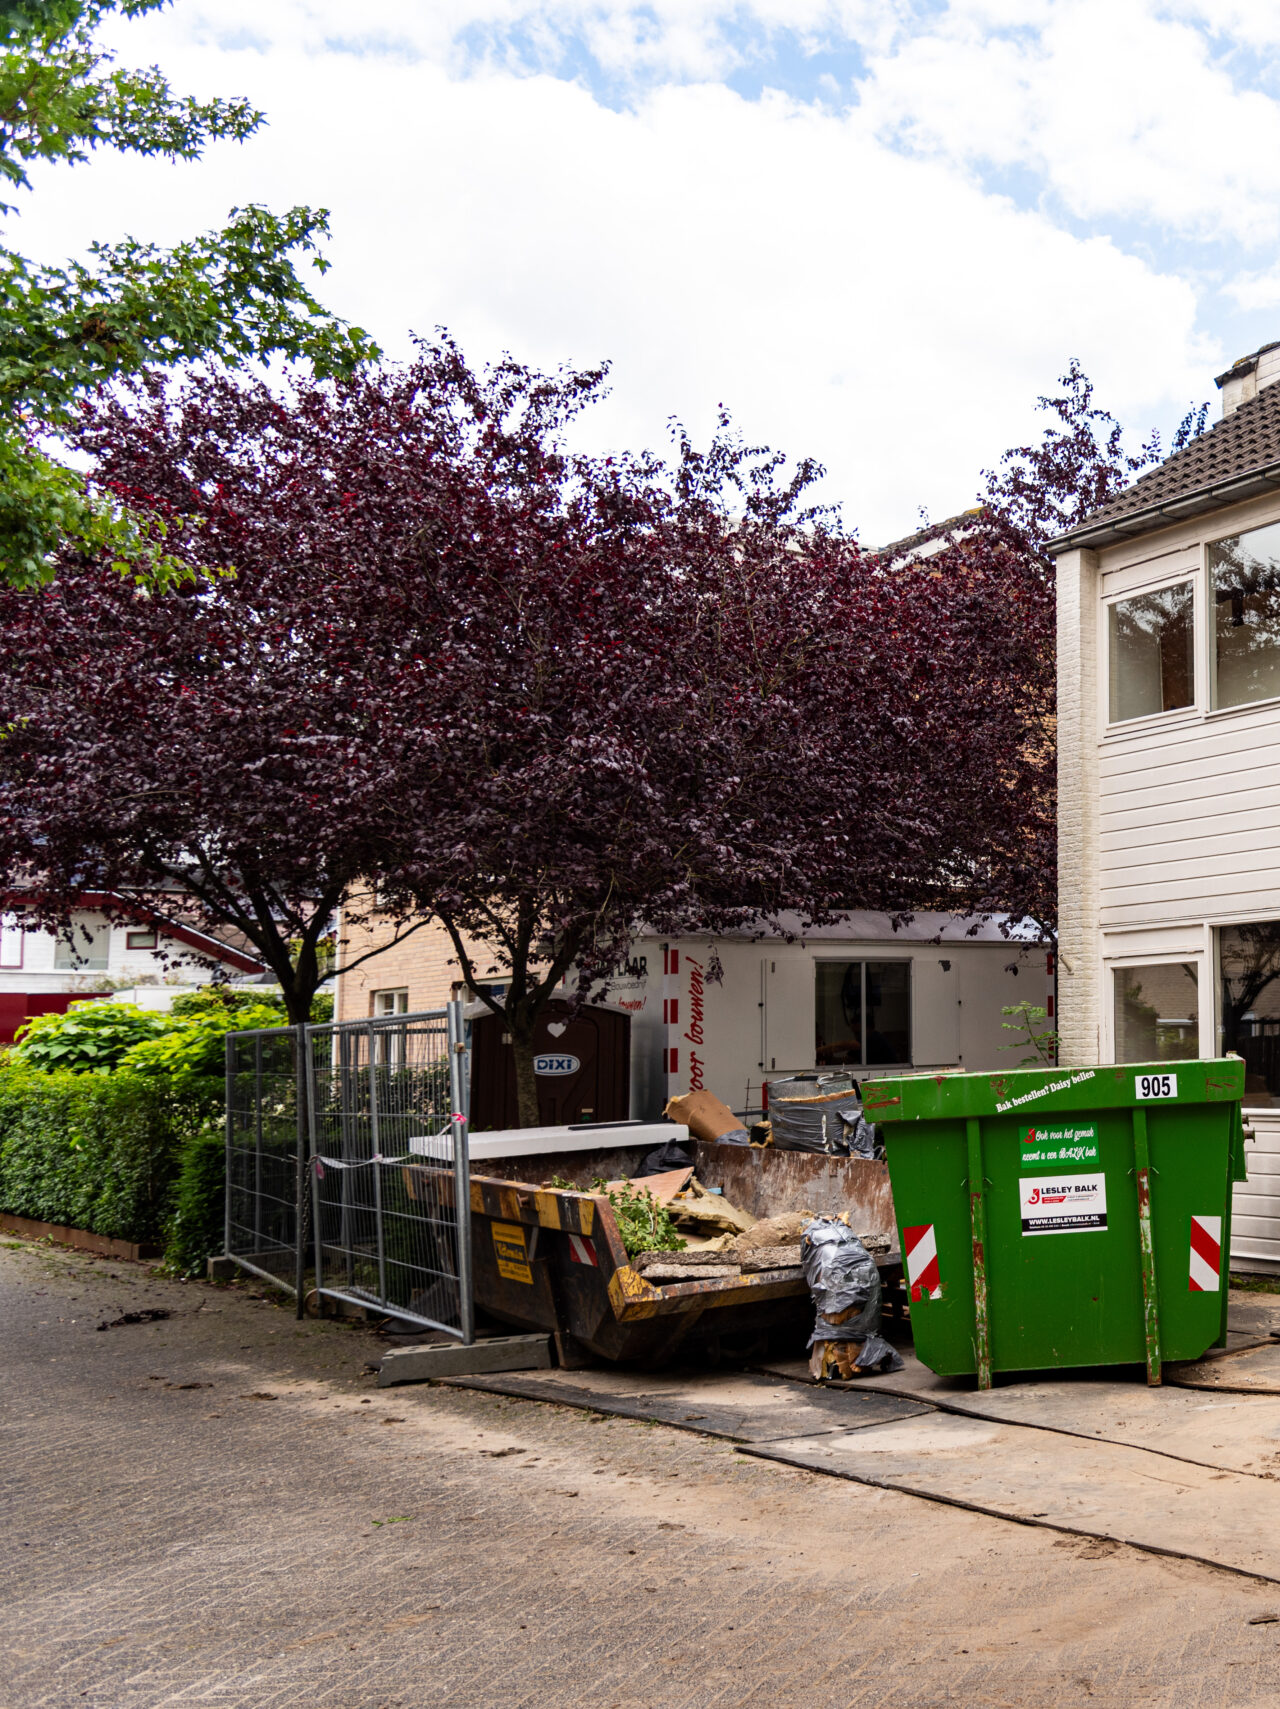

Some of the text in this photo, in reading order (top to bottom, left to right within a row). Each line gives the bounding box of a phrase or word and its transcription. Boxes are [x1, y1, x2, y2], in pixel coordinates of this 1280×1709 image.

[683, 956, 704, 1093] oor bouwen!
[995, 1070, 1096, 1113] Bak bestellen? Daisy bellen
[1141, 1076, 1171, 1098] 905
[1064, 1128, 1074, 1139] het
[1041, 1184, 1098, 1195] LESLEY BALK
[1028, 1215, 1100, 1226] WWW.LESLEYBALK.NL
